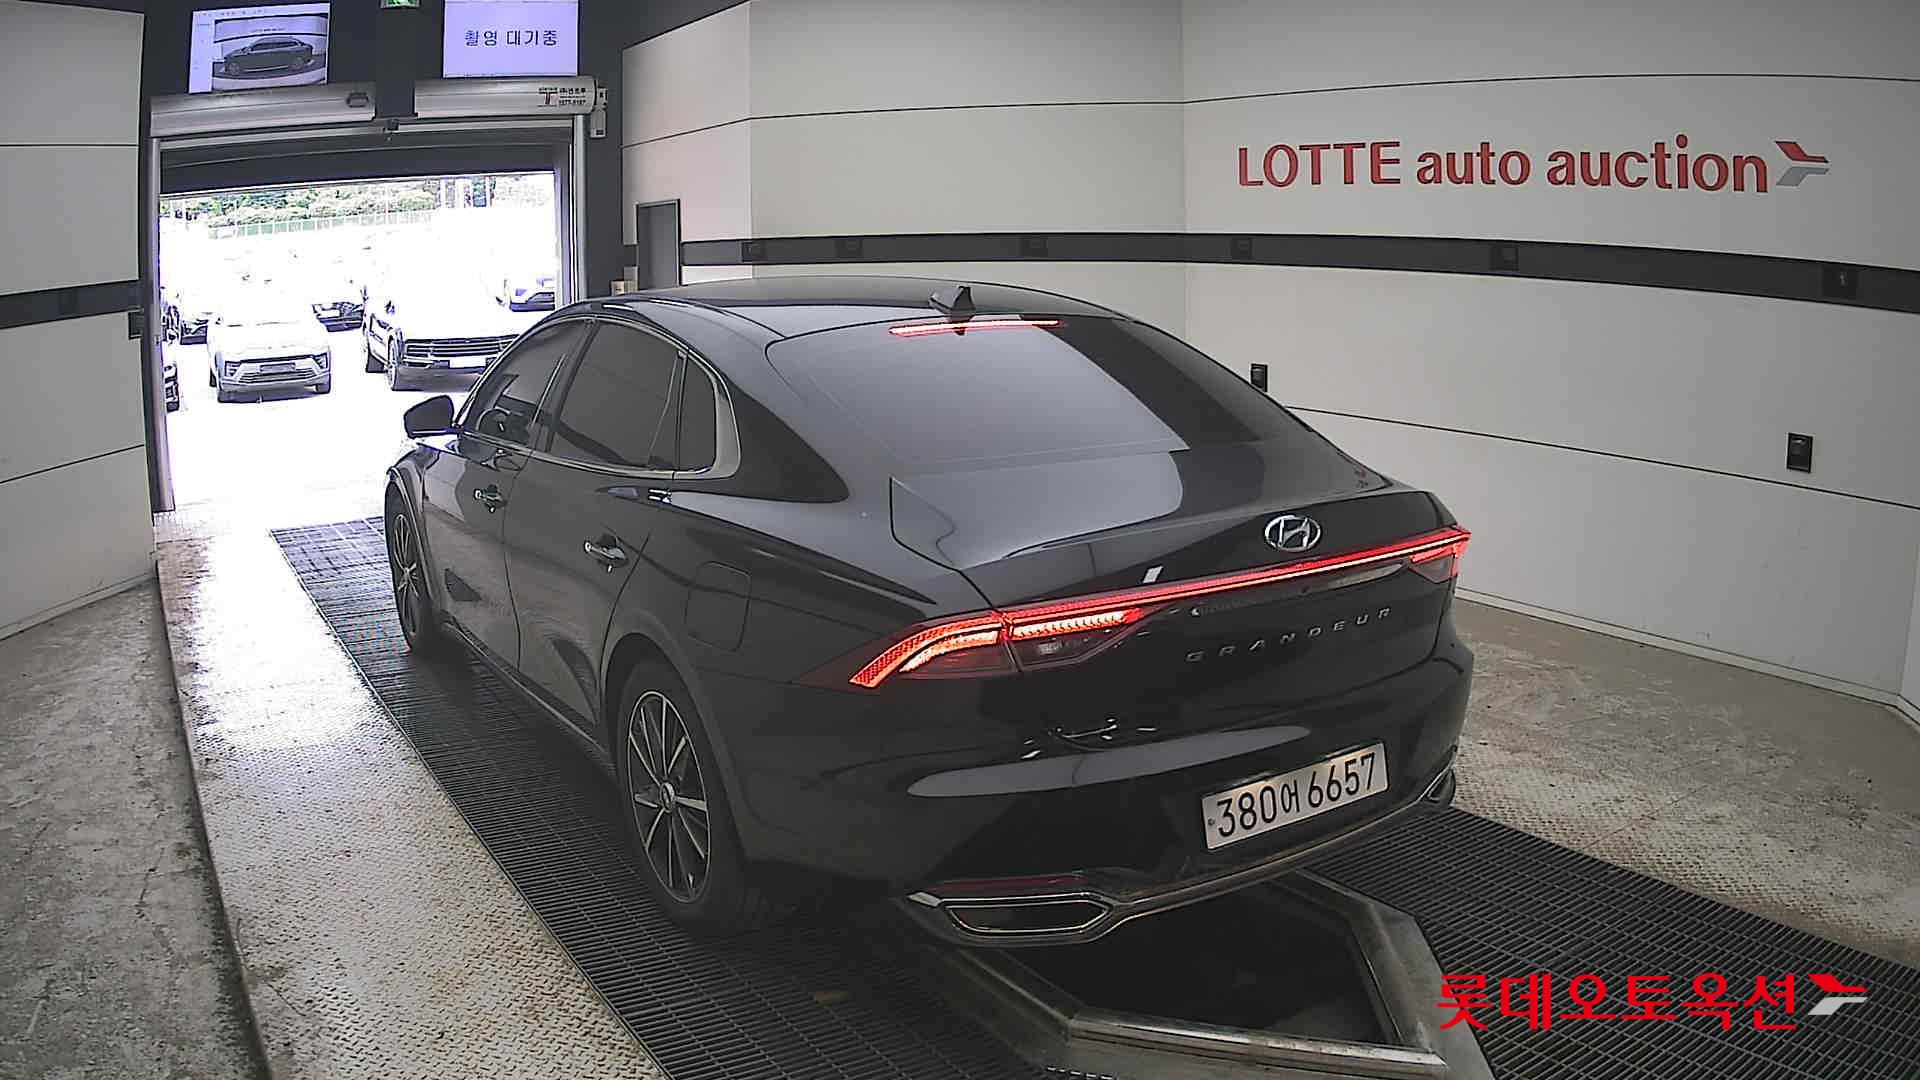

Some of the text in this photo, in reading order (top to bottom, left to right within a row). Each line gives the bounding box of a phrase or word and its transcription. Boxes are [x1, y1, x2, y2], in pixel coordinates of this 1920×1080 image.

[465, 30, 557, 46] 촬영 대기중
[1239, 134, 1769, 193] LOTTE auto auction
[1185, 607, 1390, 662] GRANDEUR
